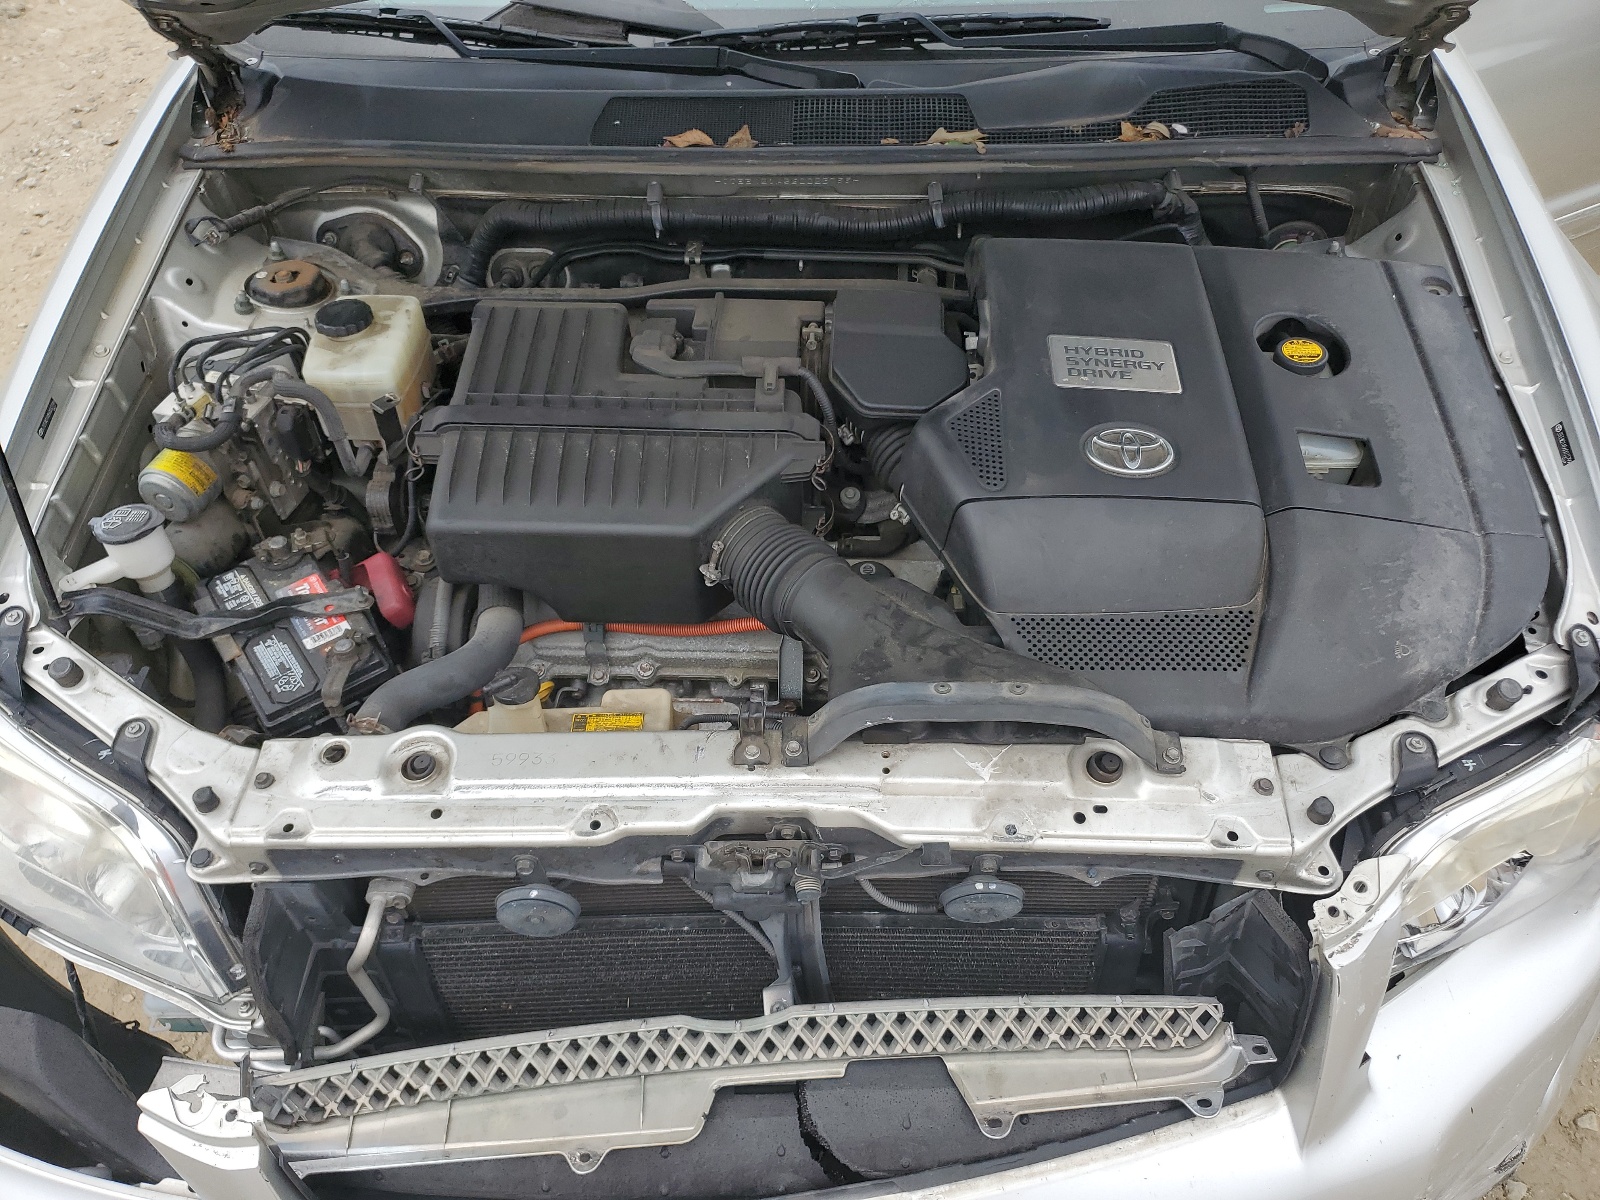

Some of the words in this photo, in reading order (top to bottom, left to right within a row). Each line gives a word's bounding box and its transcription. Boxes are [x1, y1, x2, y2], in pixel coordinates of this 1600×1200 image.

[1064, 345, 1144, 359] HYBRID
[1065, 356, 1165, 371] SYNERGY
[1067, 367, 1132, 380] DRIVE
